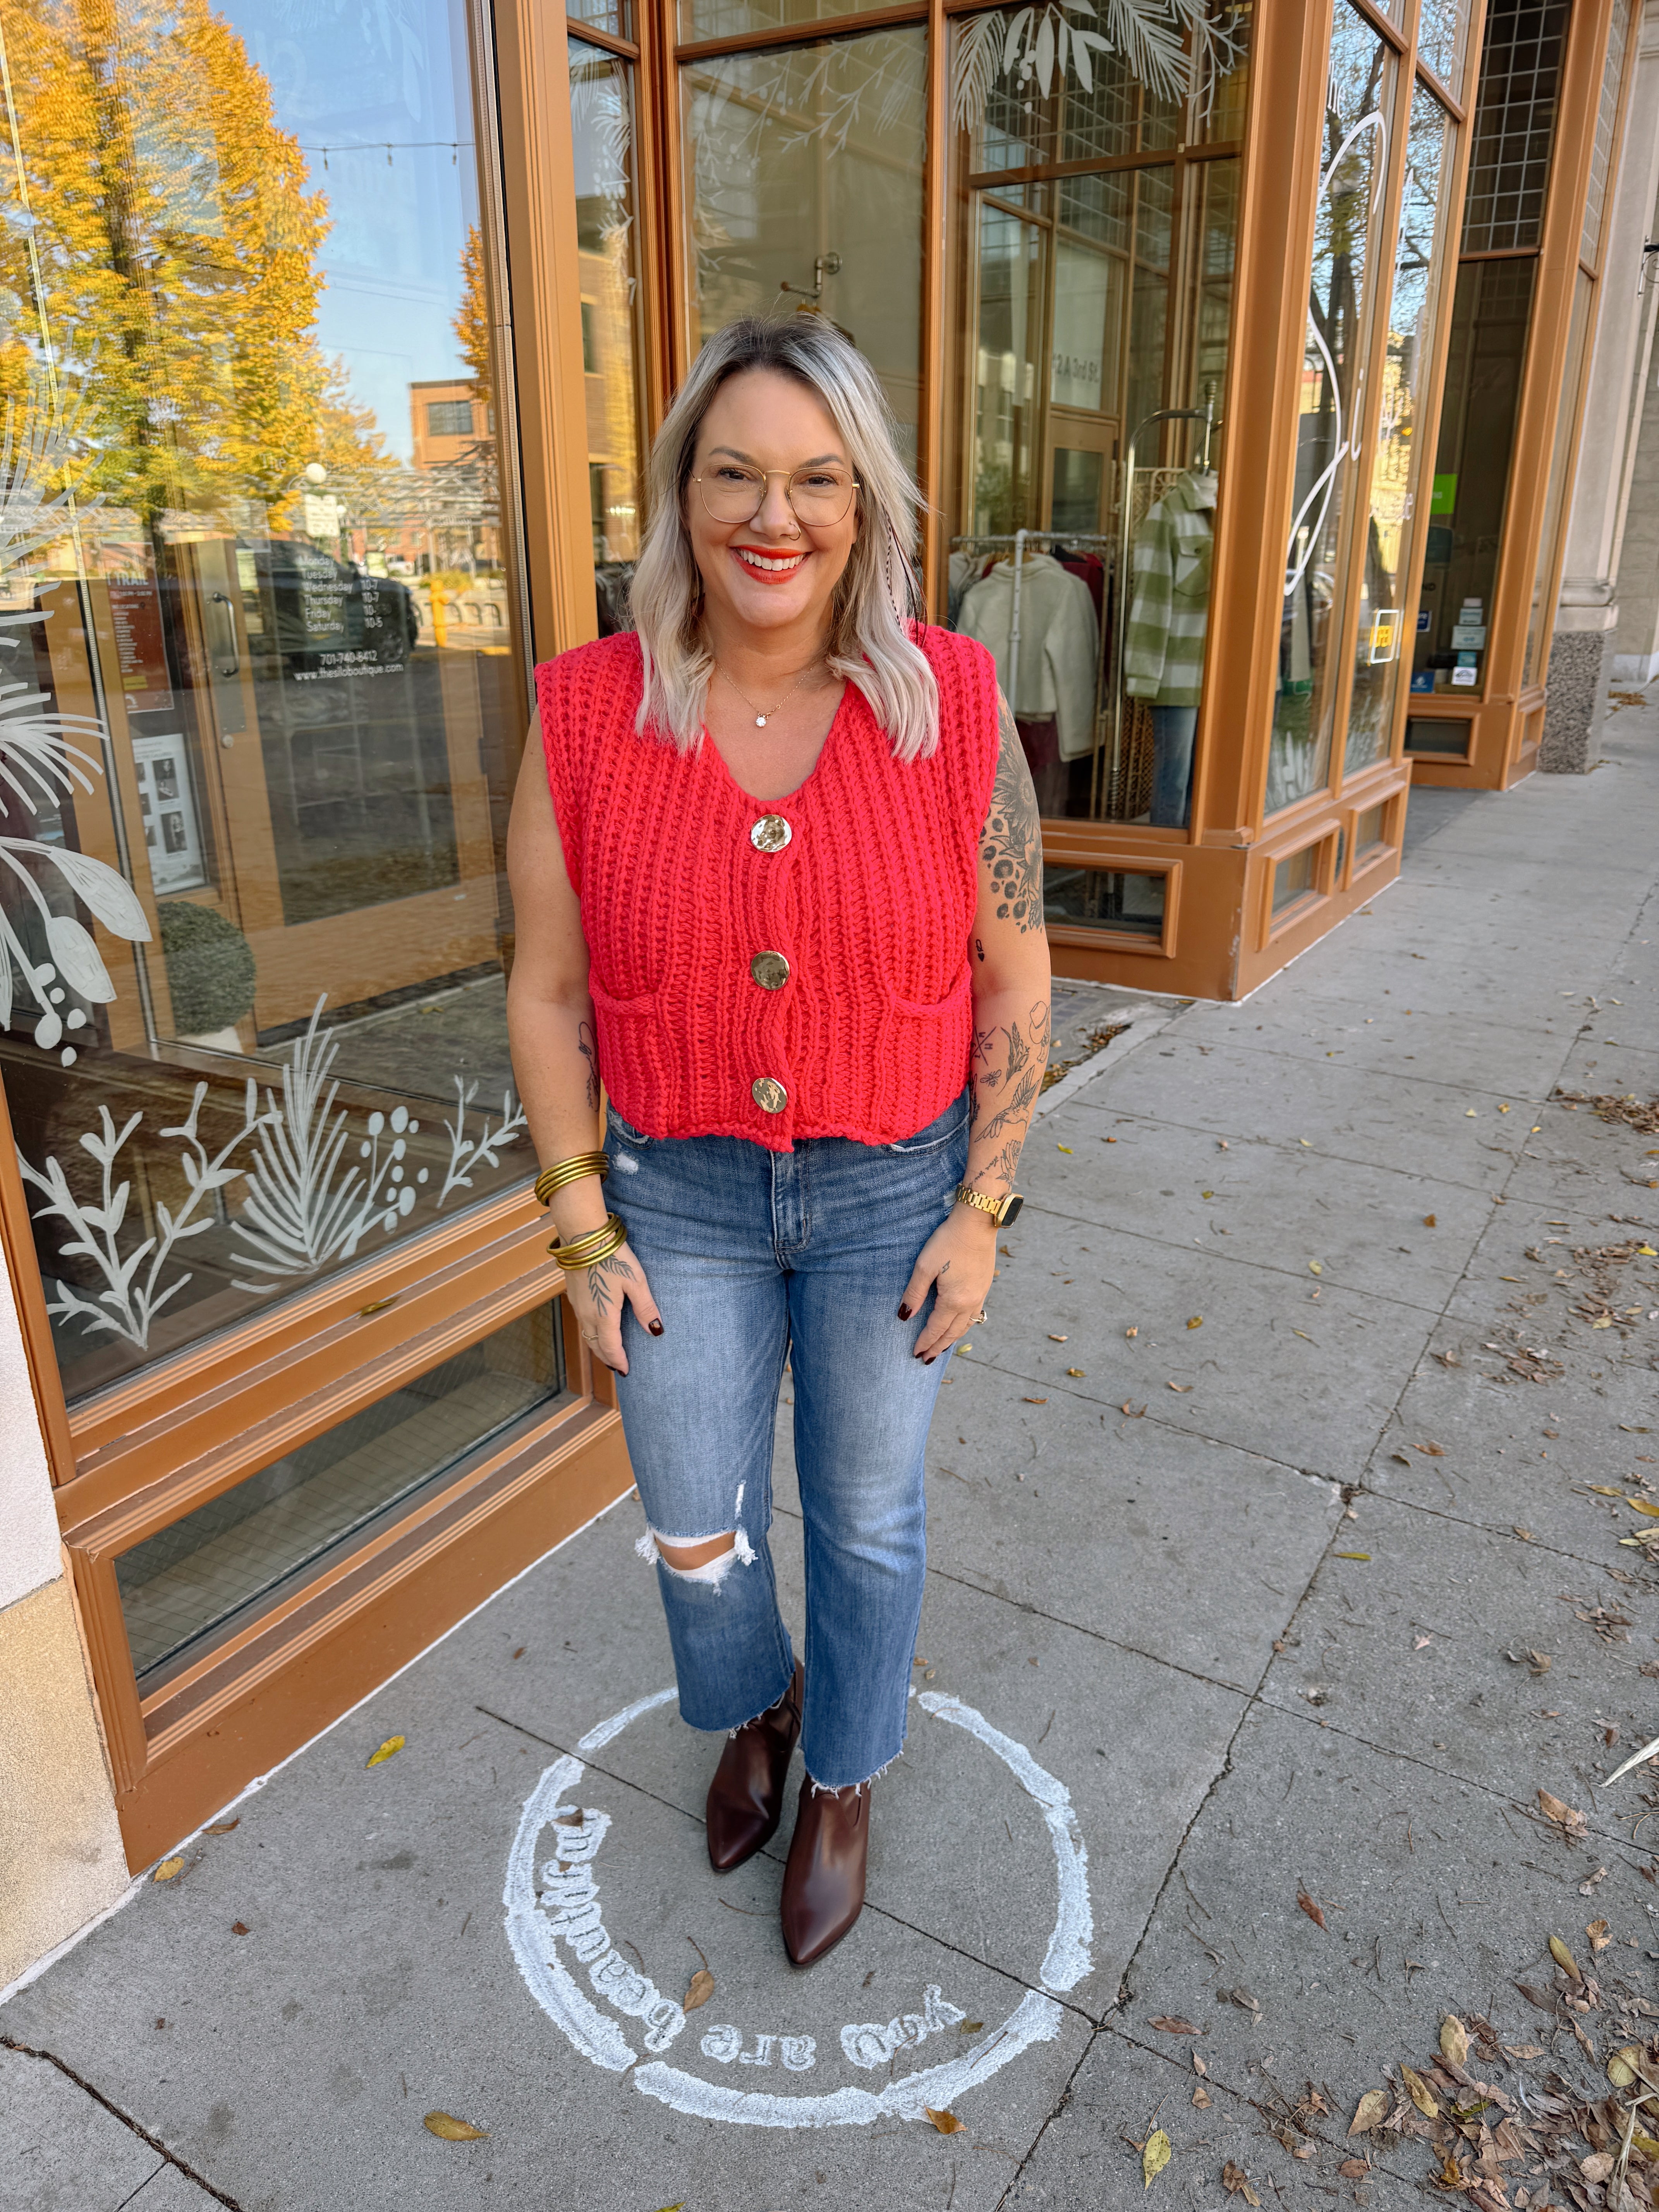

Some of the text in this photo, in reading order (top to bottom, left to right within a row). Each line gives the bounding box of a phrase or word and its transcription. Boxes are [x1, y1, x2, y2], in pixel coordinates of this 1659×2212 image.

[259, 452, 286, 468] The
[297, 555, 334, 568] Monday
[114, 571, 149, 586] TRAIL
[302, 568, 337, 580] Tuesday
[302, 579, 378, 593] Wednesday 10-7
[304, 592, 380, 607] Thursday 10-7
[305, 608, 331, 620] Friday
[306, 616, 383, 633] Saturday 10-5
[319, 649, 378, 665] 701-740-8412
[293, 663, 404, 681] www.thesiloboutique.com
[840, 1983, 967, 2070] you
[700, 2023, 817, 2071] are
